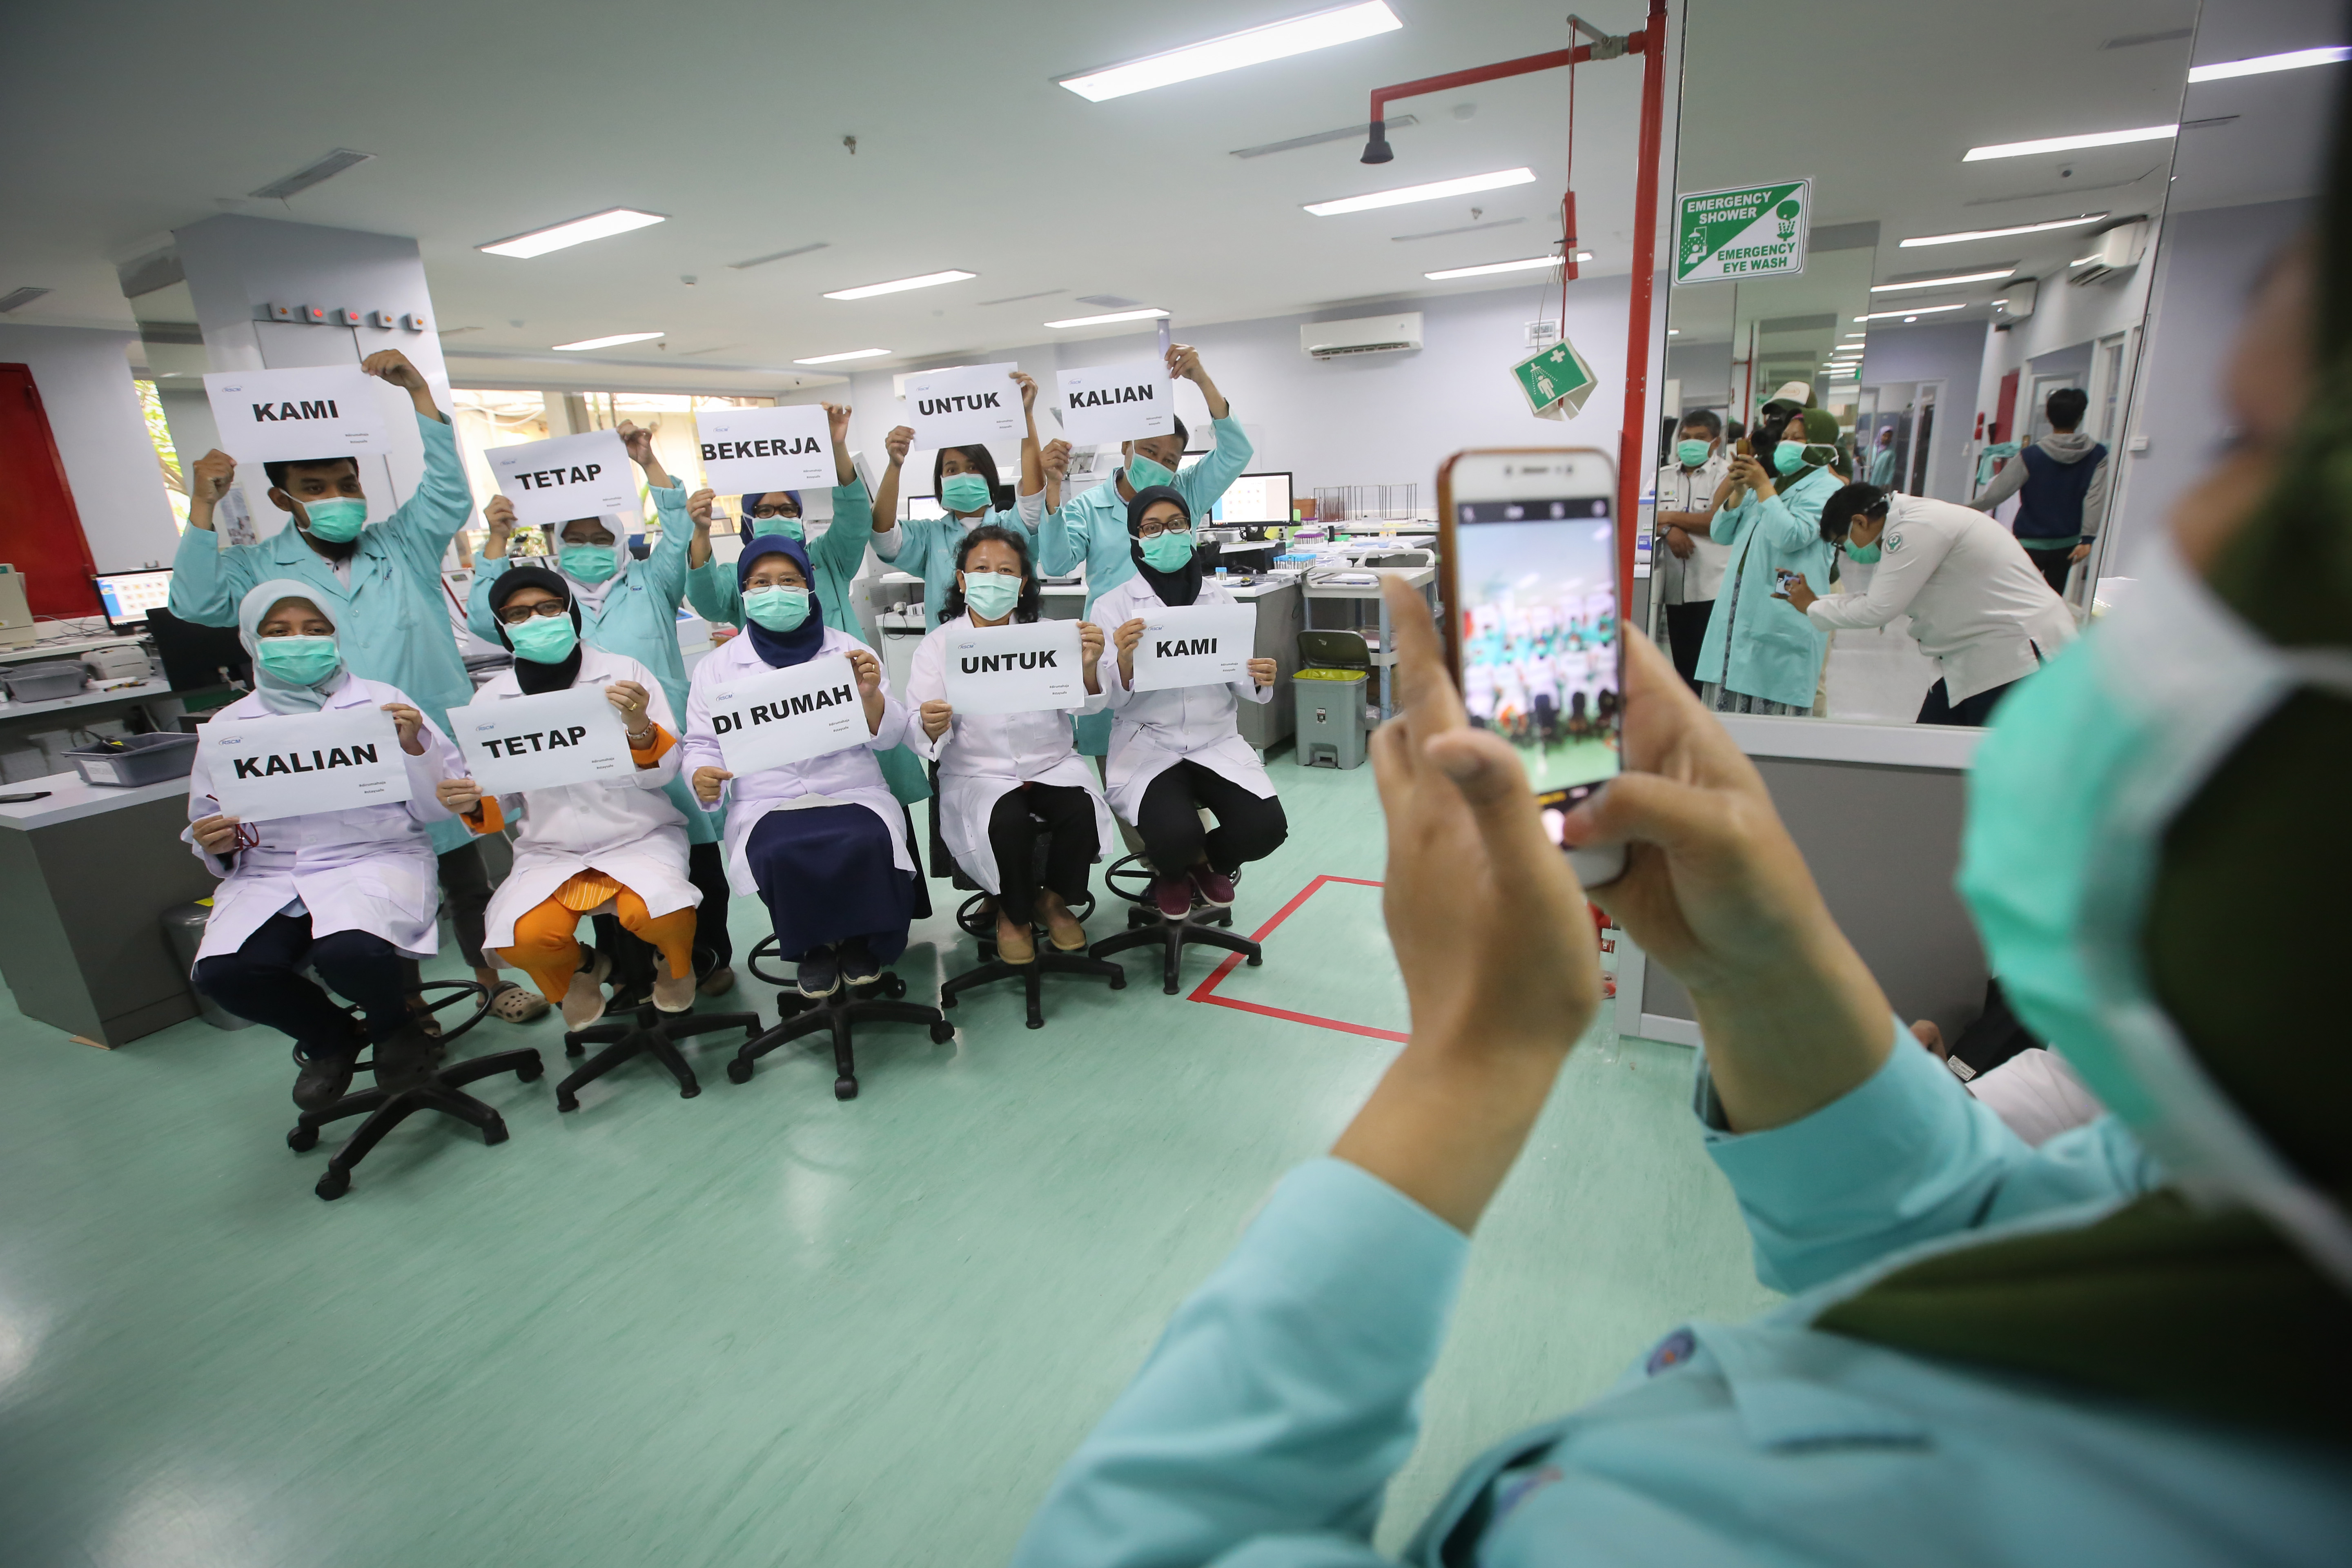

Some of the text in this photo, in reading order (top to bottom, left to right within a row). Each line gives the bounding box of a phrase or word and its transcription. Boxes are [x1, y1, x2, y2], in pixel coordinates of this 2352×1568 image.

[1687, 191, 1772, 213] EMERGENCY
[1699, 207, 1757, 225] SHOWER
[1717, 242, 1796, 261] EMERGENCY
[1723, 257, 1787, 273] EYE WASH
[919, 392, 1000, 415] UNTUK
[1069, 384, 1153, 409] KALIAN
[252, 400, 339, 422] KAMI
[701, 437, 821, 461] BEKERJA
[514, 464, 601, 490] TETAP
[1156, 638, 1217, 658] KAMI
[961, 650, 1057, 674] UNTUK
[712, 684, 853, 735] DI RUMAH
[481, 726, 586, 758] TETAP
[233, 744, 378, 779] KALIAN
